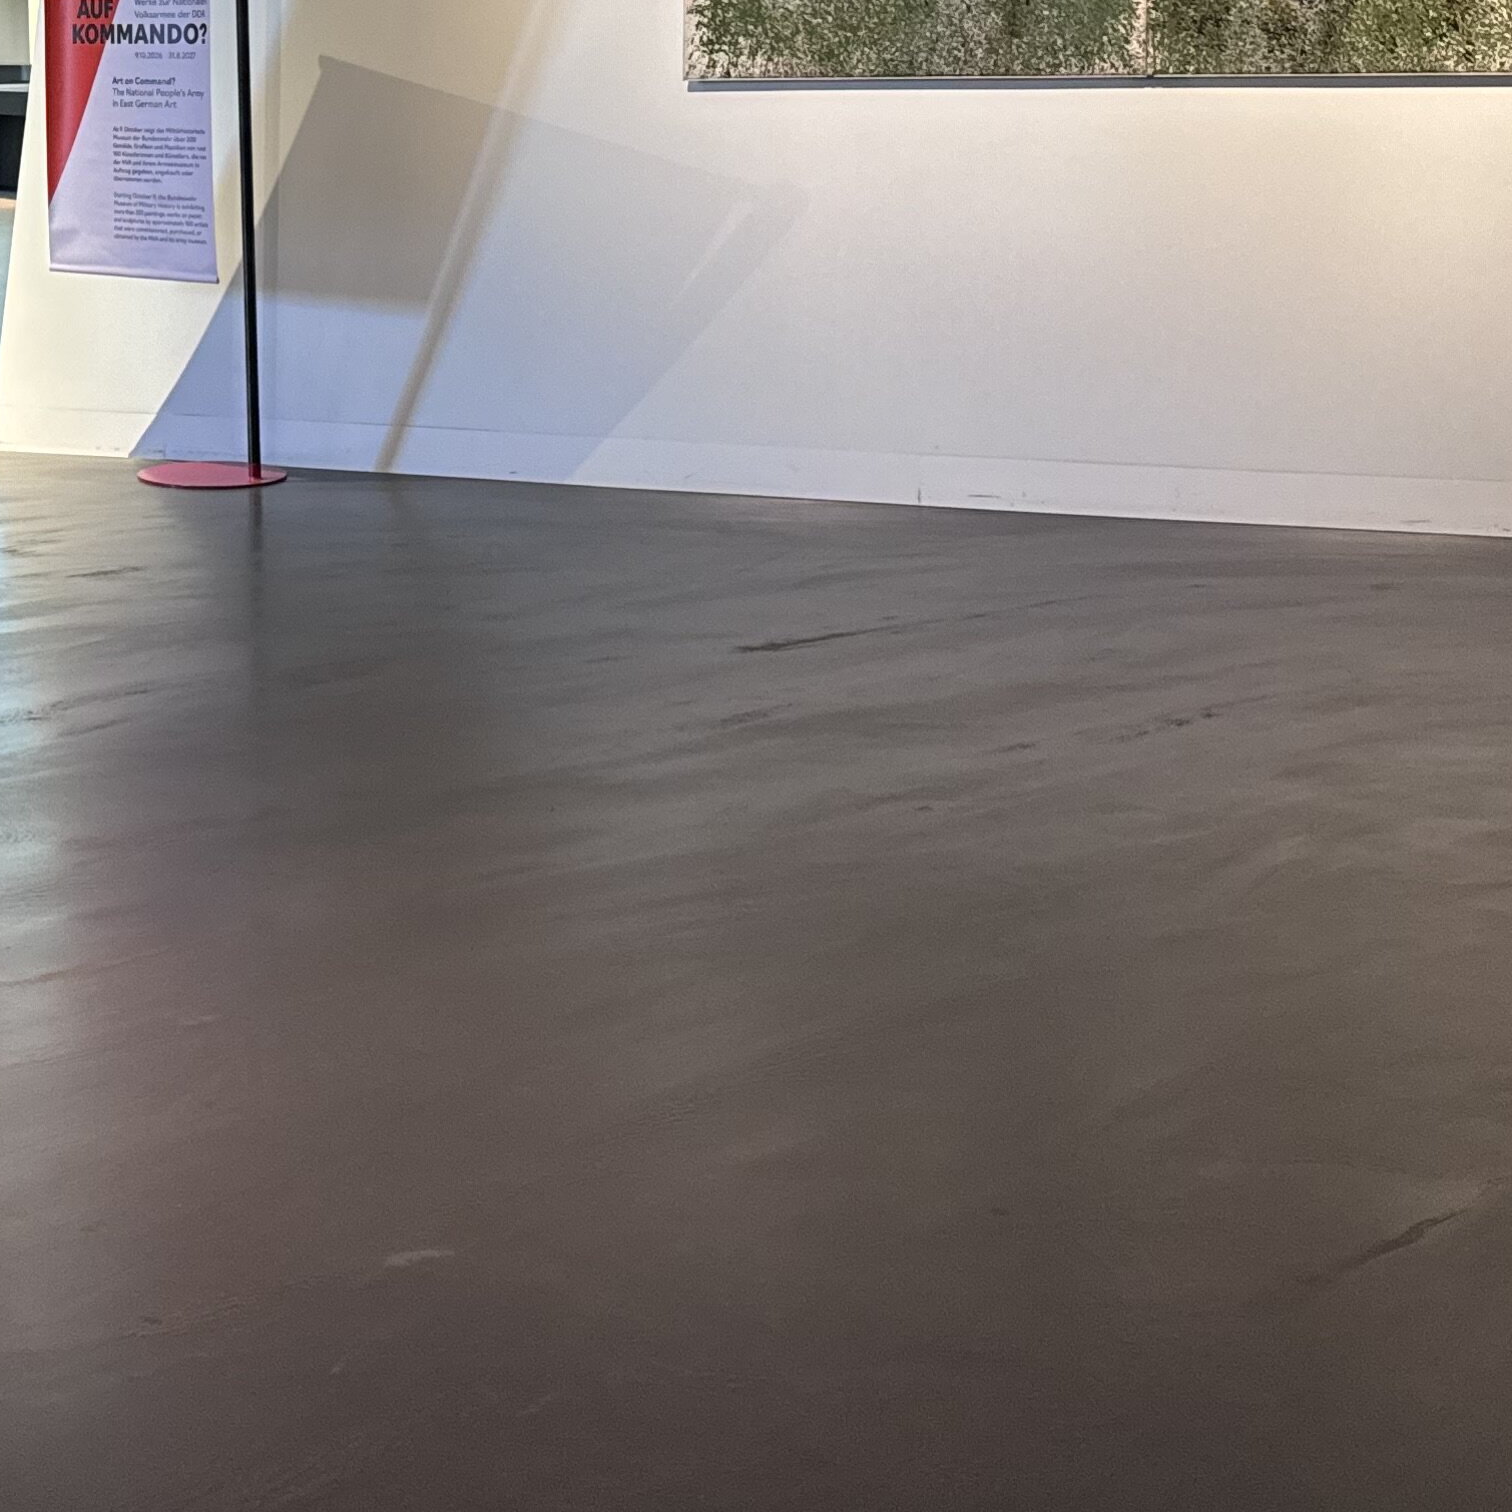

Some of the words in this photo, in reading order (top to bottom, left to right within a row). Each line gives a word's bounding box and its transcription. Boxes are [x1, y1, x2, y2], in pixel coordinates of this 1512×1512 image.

[77, 0, 113, 19] AUF
[192, 10, 206, 18] DDR
[72, 23, 207, 44] KOMMANDO?
[112, 76, 123, 84] Art
[135, 77, 176, 85] Command?
[112, 88, 124, 96] The
[126, 88, 153, 96] National
[156, 88, 185, 98] People's
[187, 89, 204, 100] Army
[120, 100, 133, 108] East
[135, 100, 163, 108] German
[164, 100, 177, 108] Art
